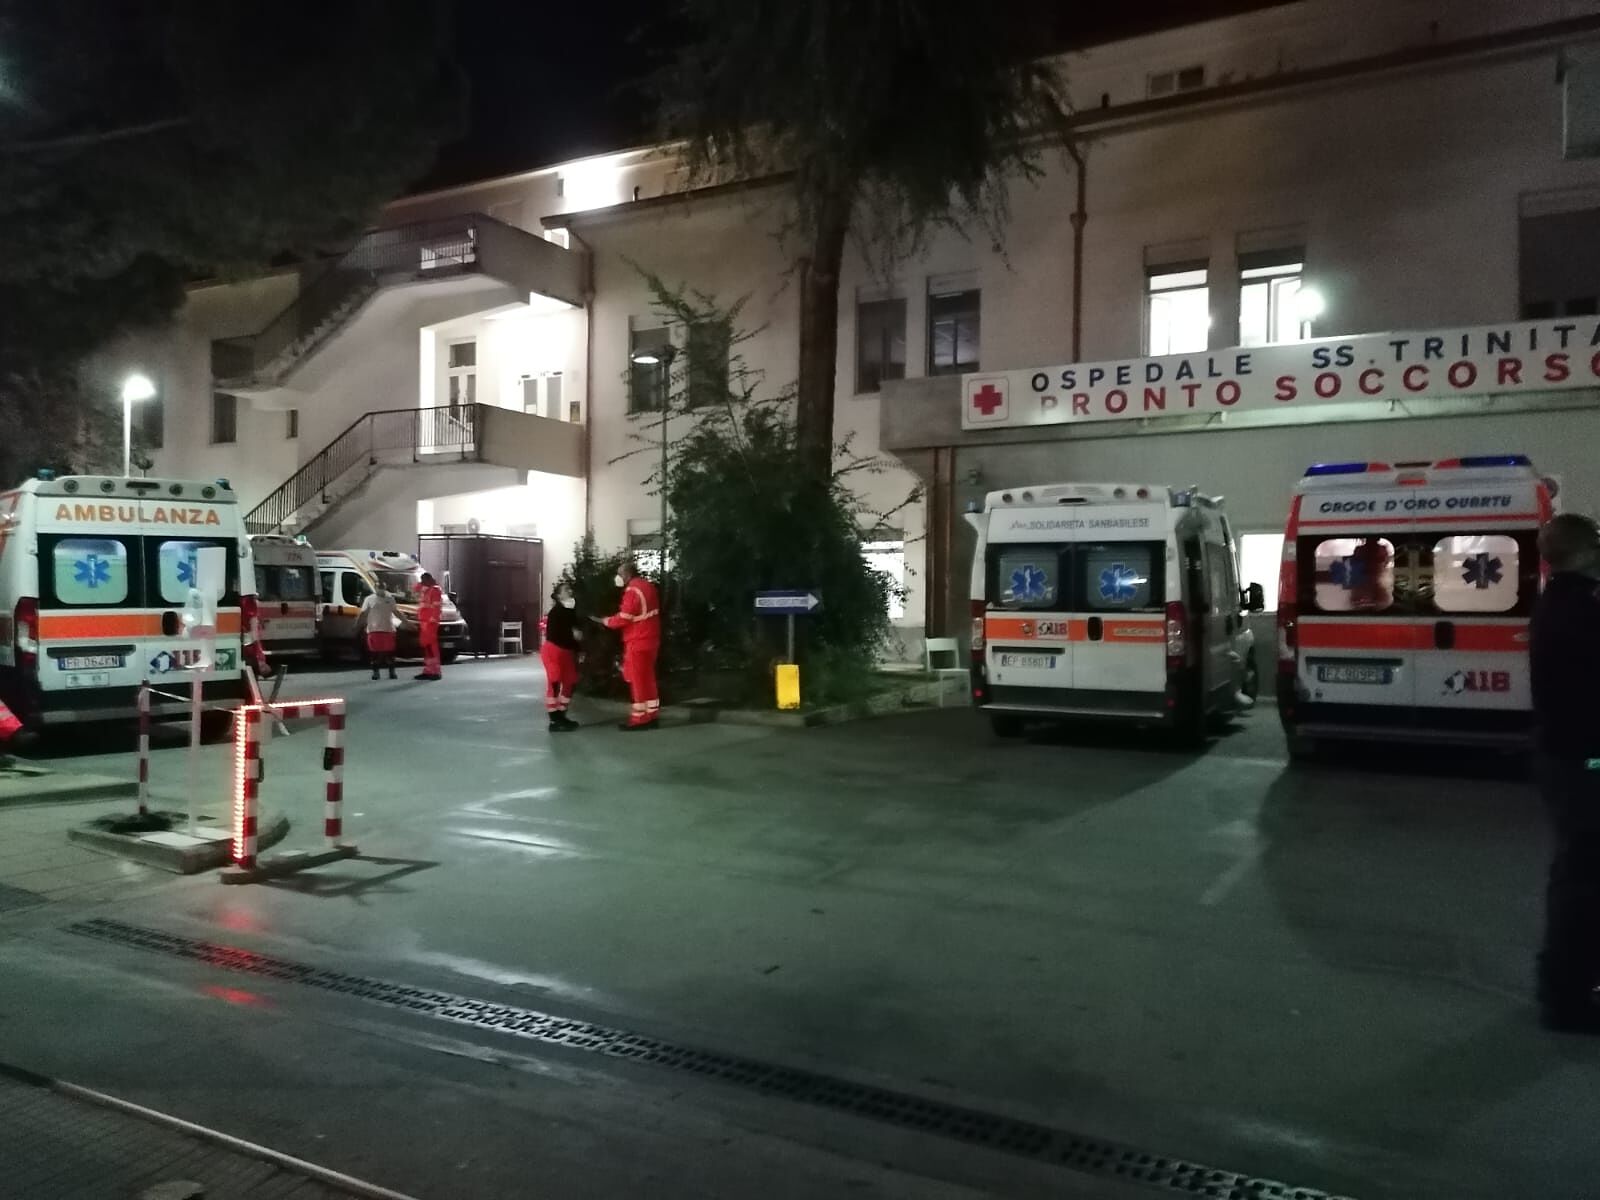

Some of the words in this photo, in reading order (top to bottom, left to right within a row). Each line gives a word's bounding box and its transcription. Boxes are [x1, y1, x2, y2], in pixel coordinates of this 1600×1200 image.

[1031, 354, 1252, 392] OSPEDALE
[1040, 379, 1242, 417] PRONTO
[55, 503, 221, 526] AMBULANZA
[1319, 500, 1377, 514] CROCE
[1383, 497, 1441, 512] D'ORO
[1465, 671, 1511, 692] 118
